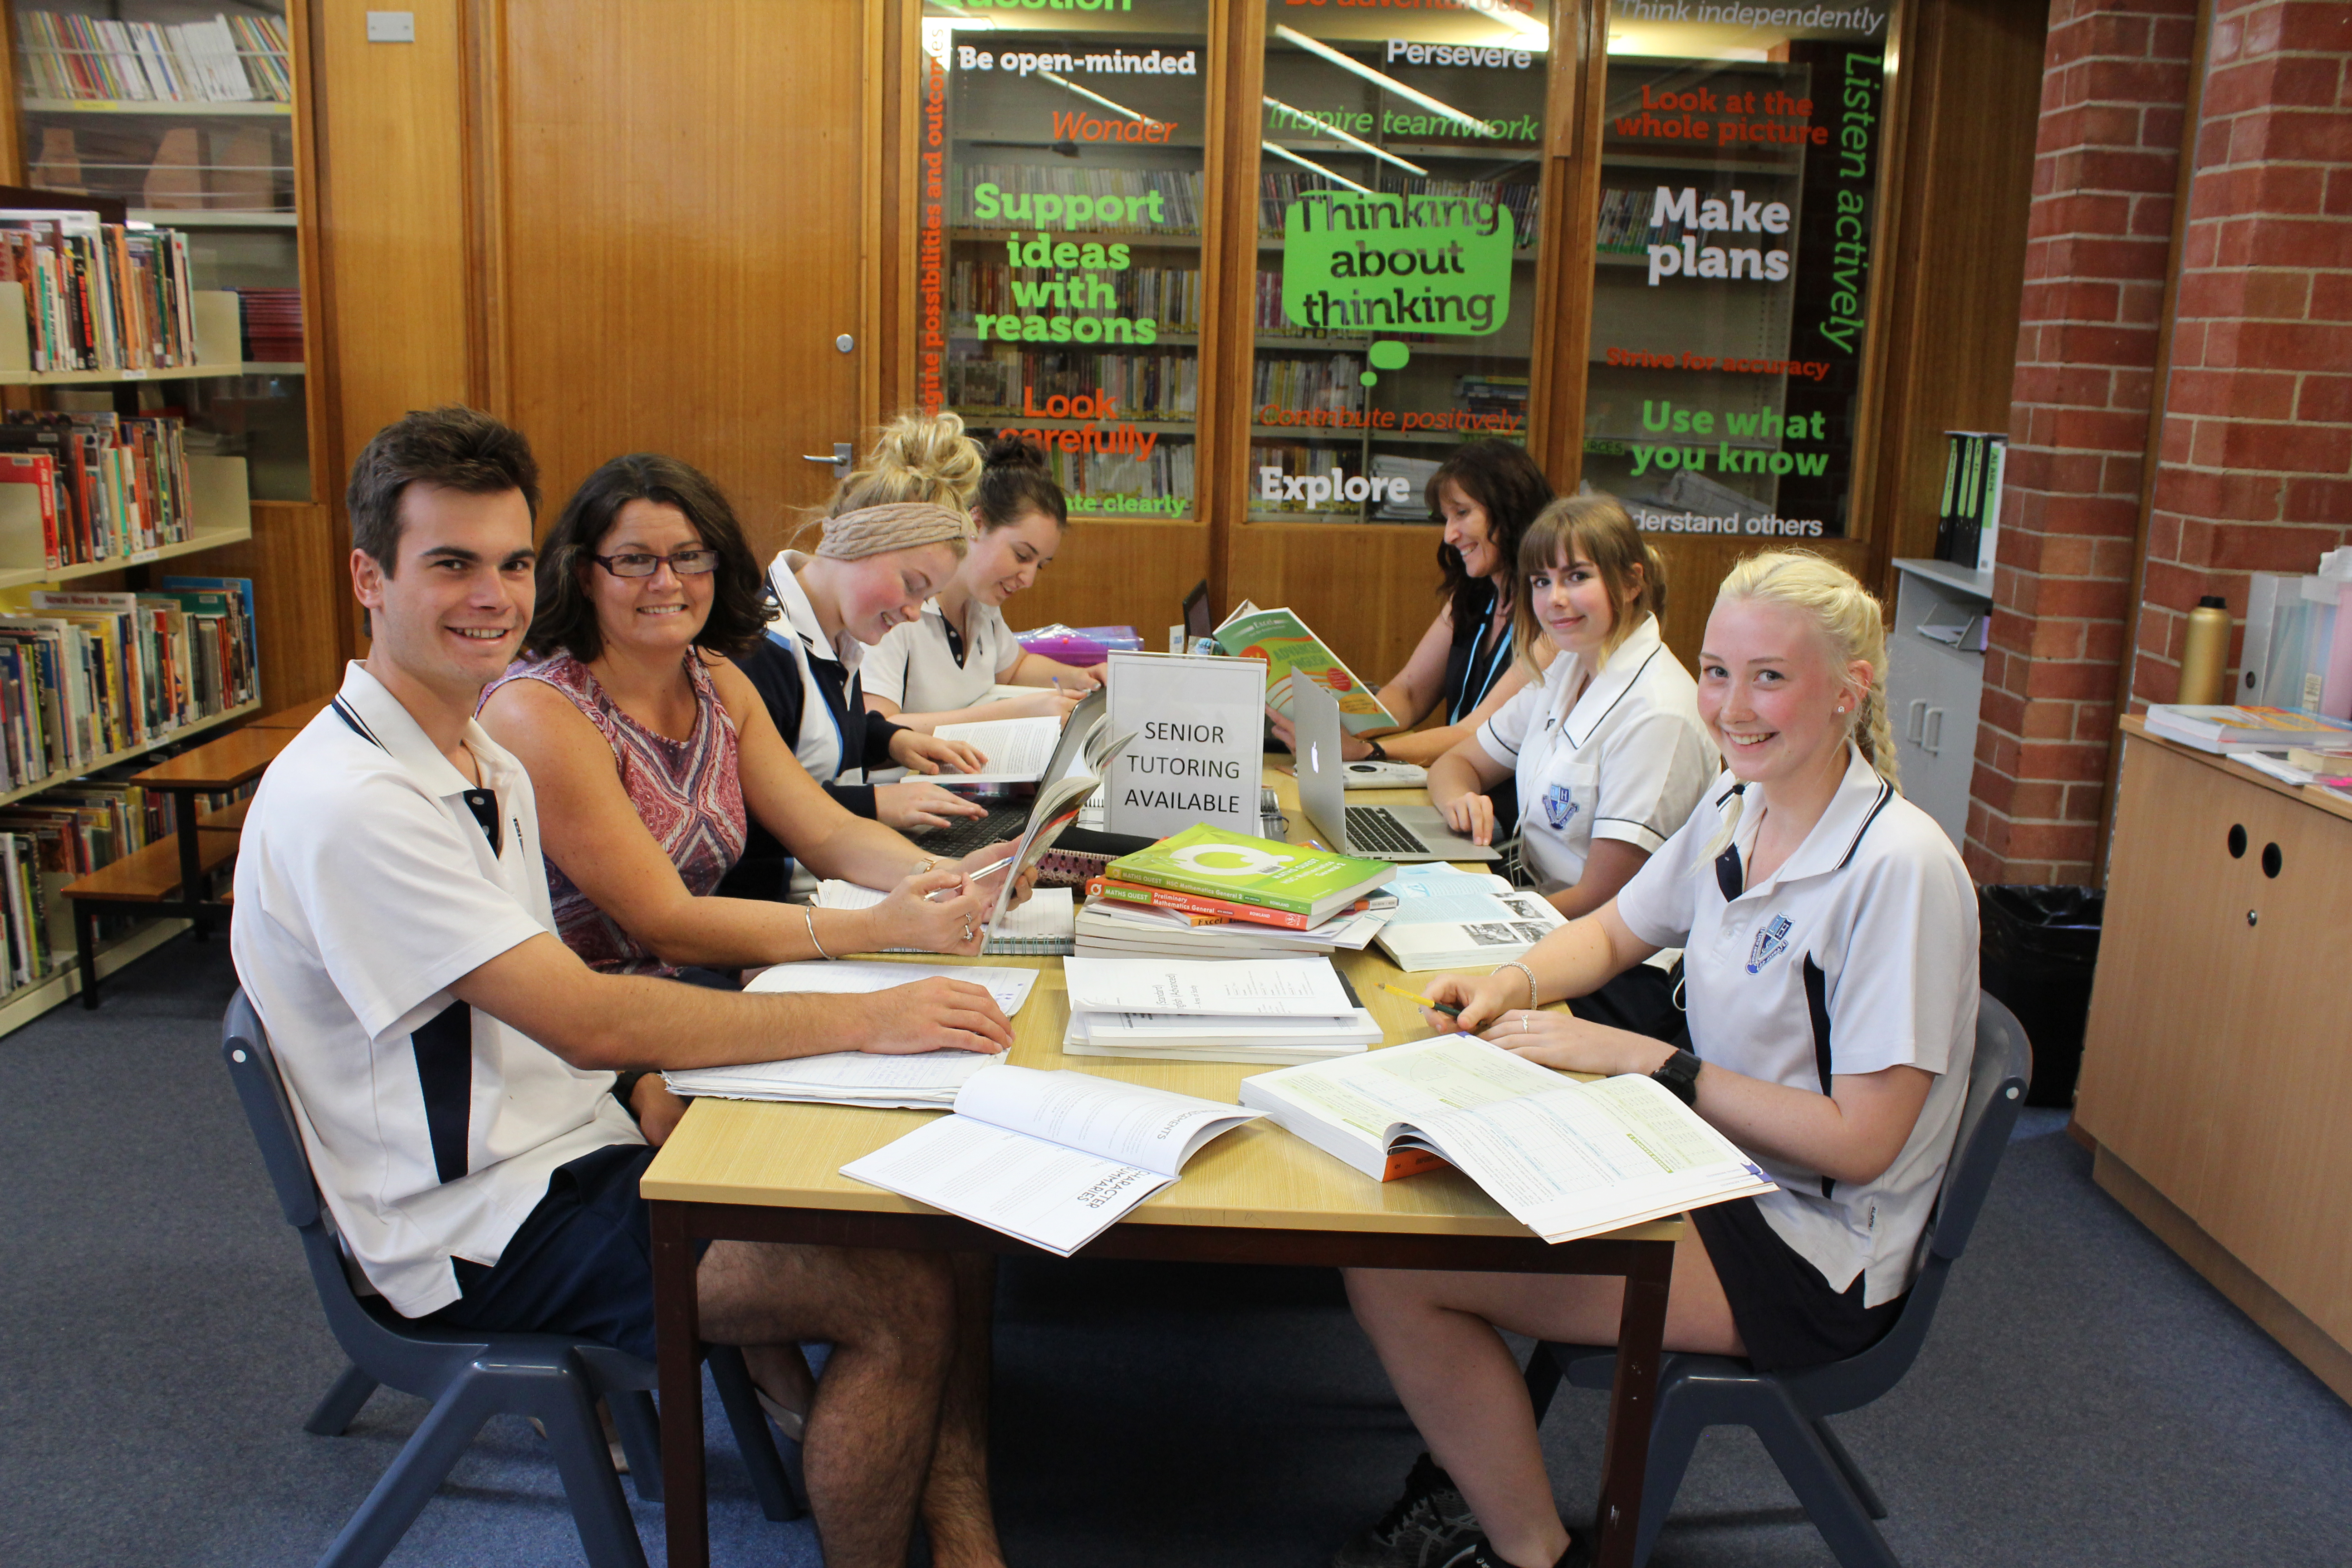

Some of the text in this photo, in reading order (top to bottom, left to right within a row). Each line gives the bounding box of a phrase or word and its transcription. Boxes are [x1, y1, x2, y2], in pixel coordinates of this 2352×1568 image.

[1697, 1, 1885, 35] independently
[958, 45, 1197, 77] Be open-minded
[1387, 39, 1532, 68] Persevere
[1641, 85, 1813, 117] Look at the
[1052, 111, 1178, 143] Wonder
[1267, 102, 1539, 141] Inspire teamwork
[1615, 113, 1828, 146] whole picture
[974, 183, 1165, 230] Support
[1298, 194, 1501, 236] Thinking
[1650, 186, 1791, 234] Make
[1820, 52, 1882, 354] Listen actively
[920, 28, 944, 417] agine possibilities and outcomes
[1007, 232, 1131, 270] ideas
[1331, 240, 1465, 278] about
[1647, 235, 1789, 286] plans
[1011, 274, 1117, 309] with
[1303, 286, 1495, 332] thinking
[975, 314, 1157, 344] reasons
[1607, 348, 1830, 382] Strive for accuracy
[1024, 386, 1117, 420] Look
[1259, 404, 1522, 436] Contribute positively
[1642, 400, 1826, 440] Use what
[1631, 441, 1829, 476] you know
[1259, 466, 1411, 510] Explore
[1103, 494, 1186, 518] clearly
[1745, 513, 1823, 536] others
[1145, 722, 1224, 744] SENIOR
[1127, 755, 1240, 779] TUTORING
[1124, 789, 1240, 813] AVAILABLE
[1105, 888, 1148, 901] MATHS QUEST
[1122, 872, 1142, 882] MATHS
[1143, 876, 1162, 885] QUEST
[1180, 882, 1214, 894] Mathematics
[1215, 889, 1238, 899] General
[1154, 892, 1188, 904] Preliminary
[1153, 898, 1190, 910] Mathematics
[1191, 904, 1215, 914] General
[1198, 917, 1223, 926] Excel
[1076, 1165, 1140, 1202] SUMMARIES
[1085, 1171, 1151, 1210] CHARACTER
